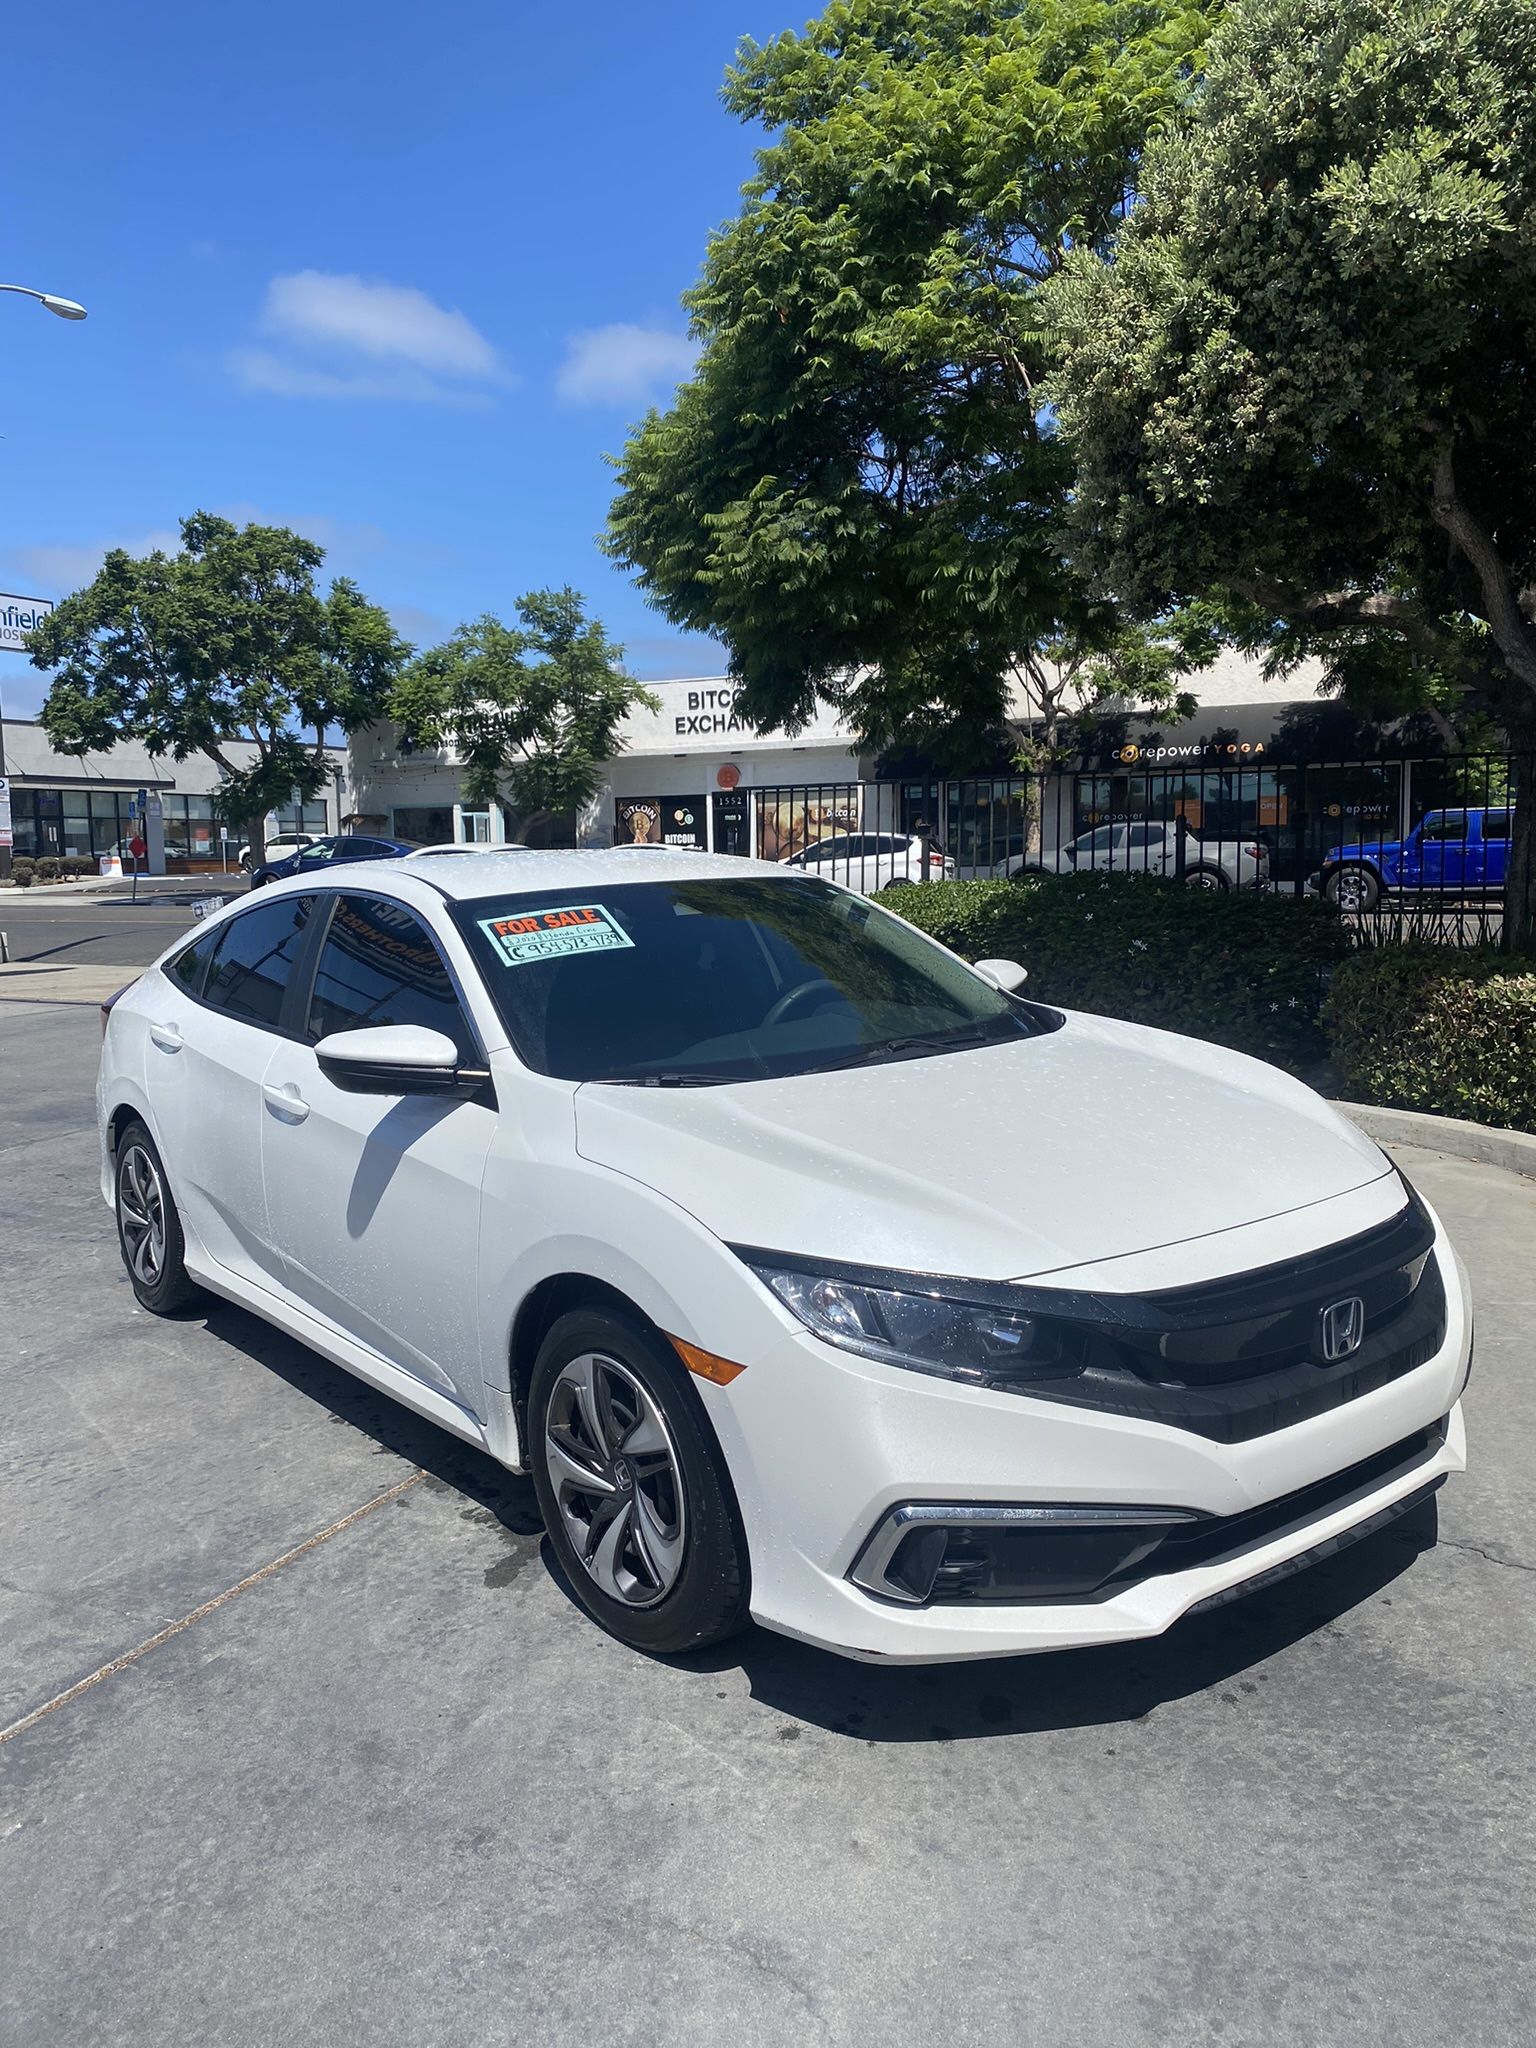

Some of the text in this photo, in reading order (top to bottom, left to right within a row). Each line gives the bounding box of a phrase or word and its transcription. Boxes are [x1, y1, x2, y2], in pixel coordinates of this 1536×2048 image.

[675, 714, 757, 735] EXCHAN
[1111, 742, 1265, 763] corepower YOGA
[719, 797, 741, 806] 1552
[622, 804, 657, 820] BITCOIN
[664, 833, 696, 844] BITCOIN
[494, 909, 602, 936] FOR SALE
